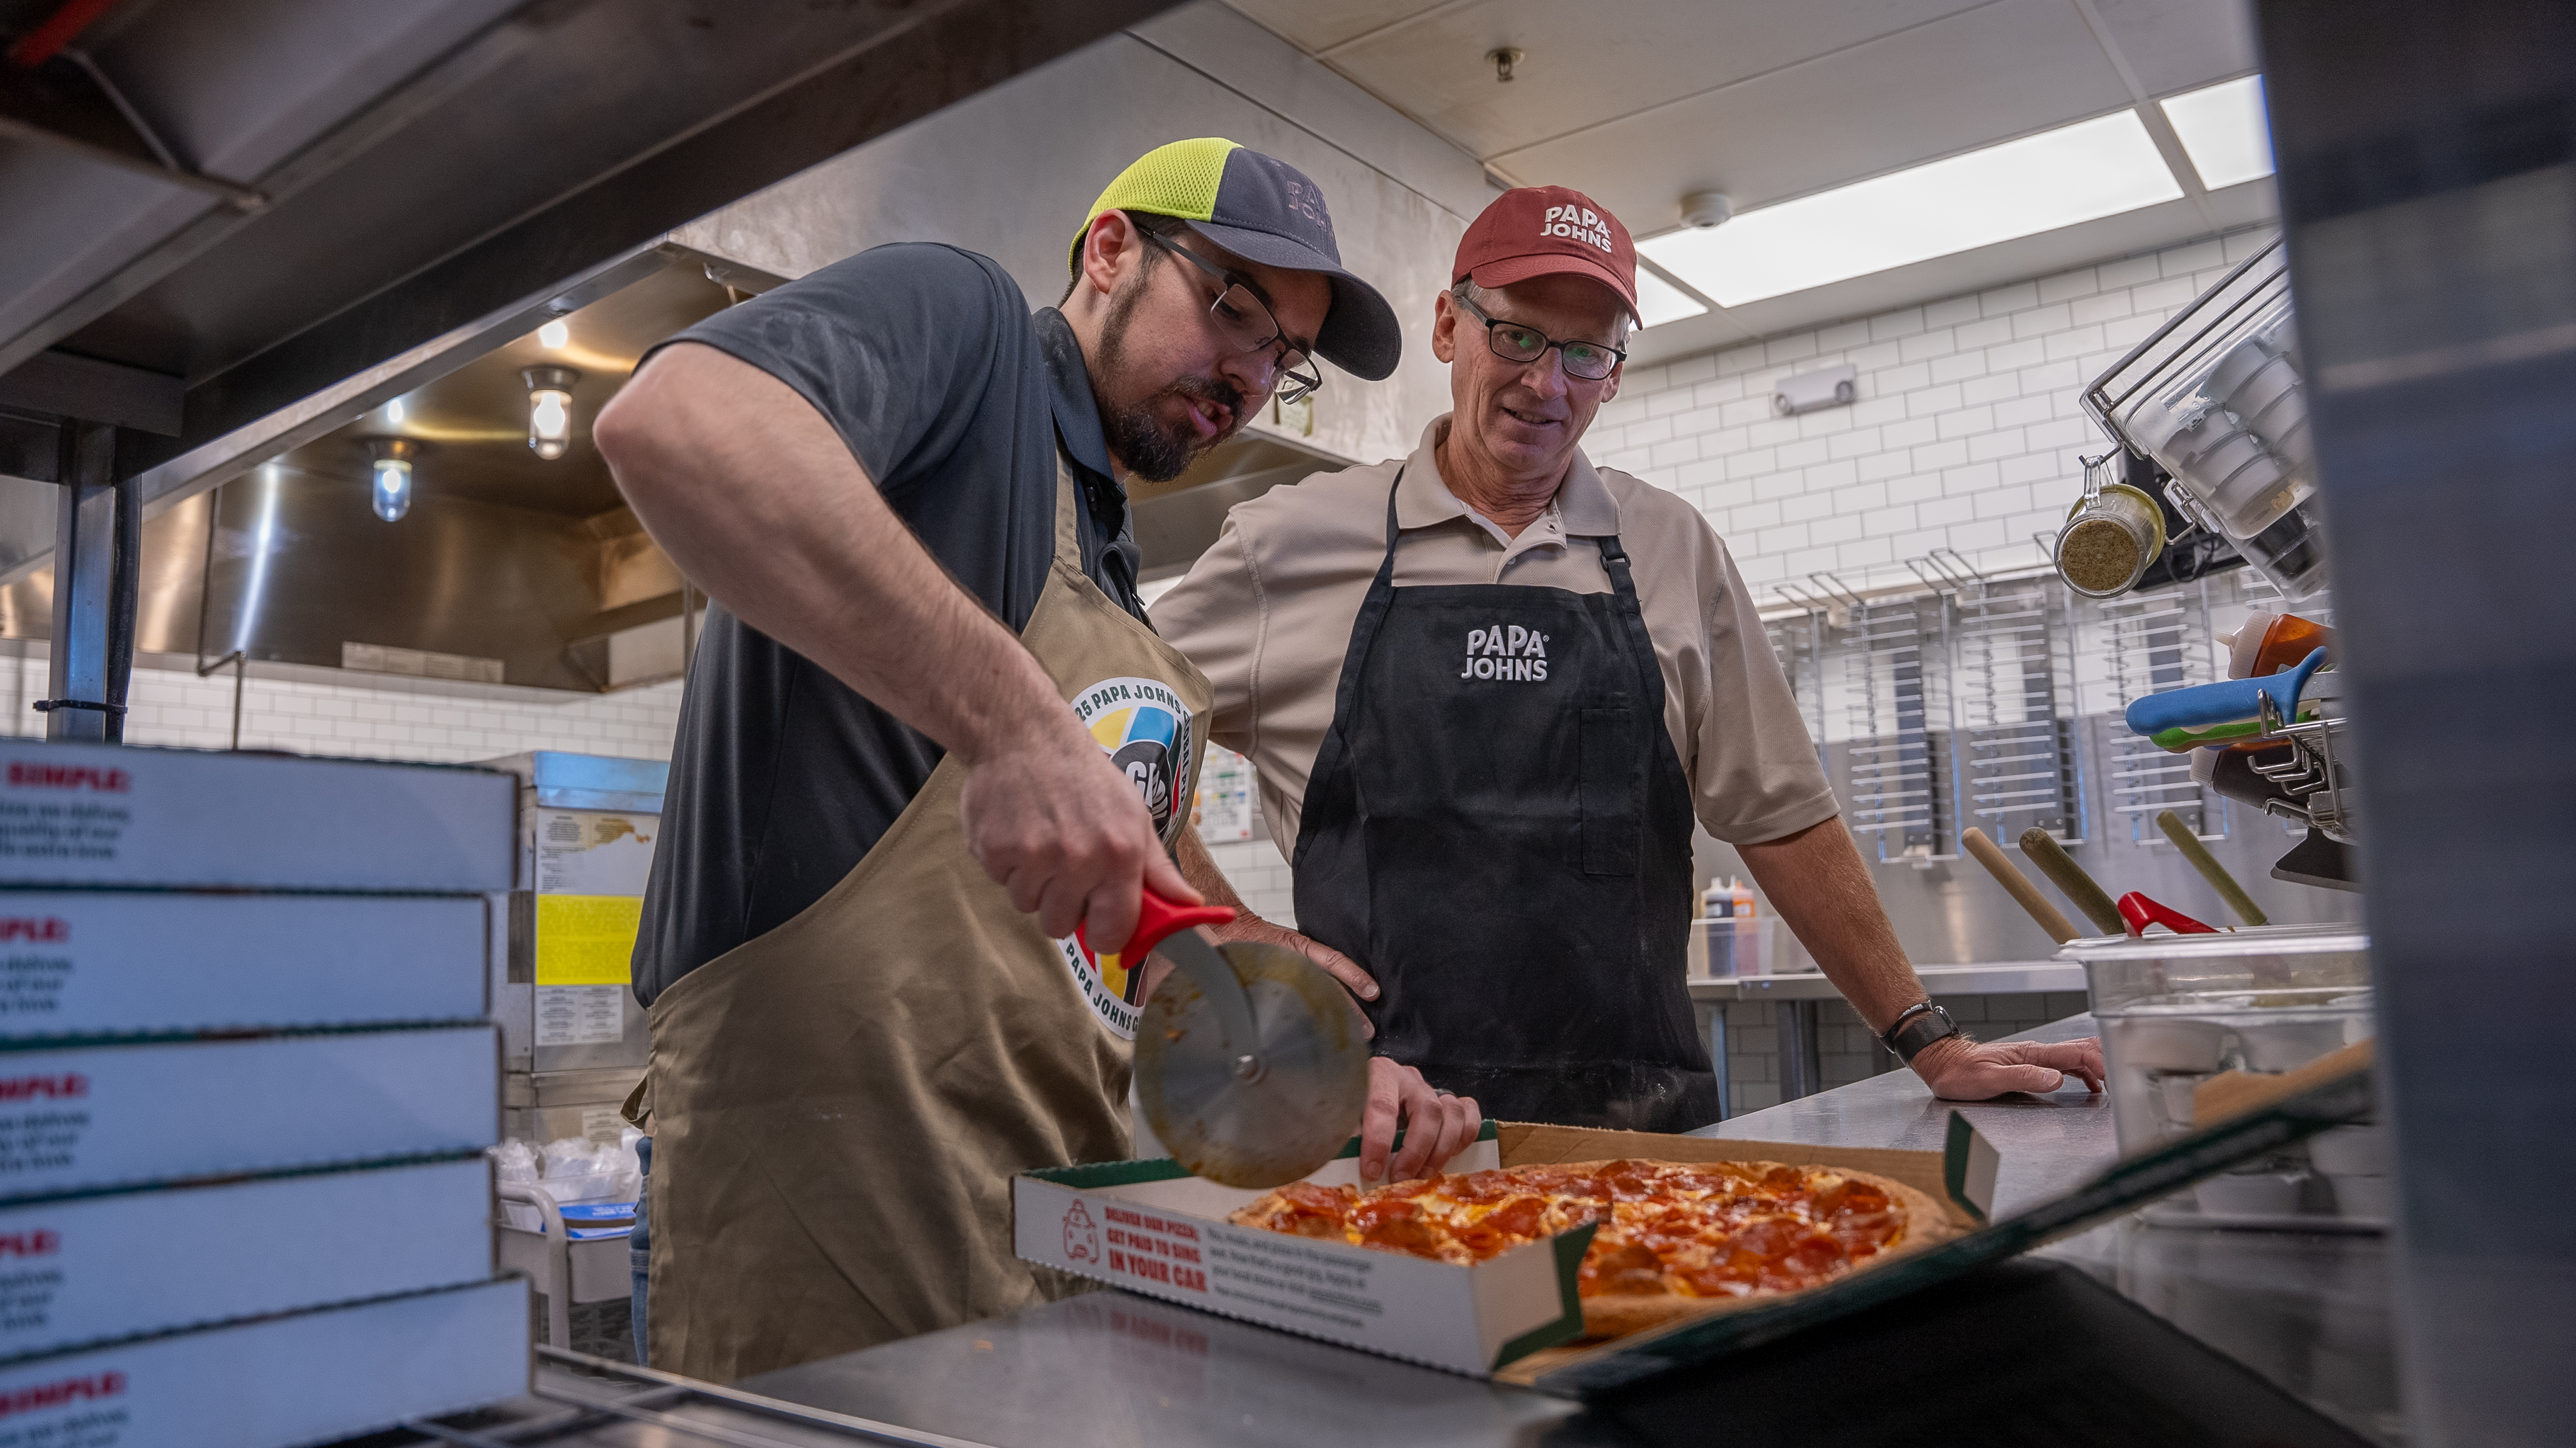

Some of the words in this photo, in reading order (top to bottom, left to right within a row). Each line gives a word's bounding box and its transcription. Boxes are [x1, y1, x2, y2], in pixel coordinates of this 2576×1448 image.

[1540, 223, 1612, 253] JOHNS
[1545, 204, 1611, 240] PAPA
[1461, 657, 1547, 681] JOHNS
[1091, 685, 1131, 709] PAPA
[1134, 685, 1182, 715] JOHNS
[1066, 942, 1093, 997] PAPA
[1094, 992, 1132, 1031] JOHNS
[1105, 1206, 1141, 1226] DELIVER
[1145, 1216, 1163, 1231] OUR
[1107, 1228, 1125, 1245] GET
[1128, 1232, 1153, 1252] PAID
[1156, 1239, 1169, 1255] TO
[1173, 1243, 1201, 1263] SING
[1109, 1249, 1125, 1272] IN
[1128, 1255, 1171, 1283] YOUR
[1173, 1265, 1208, 1293] CAR
